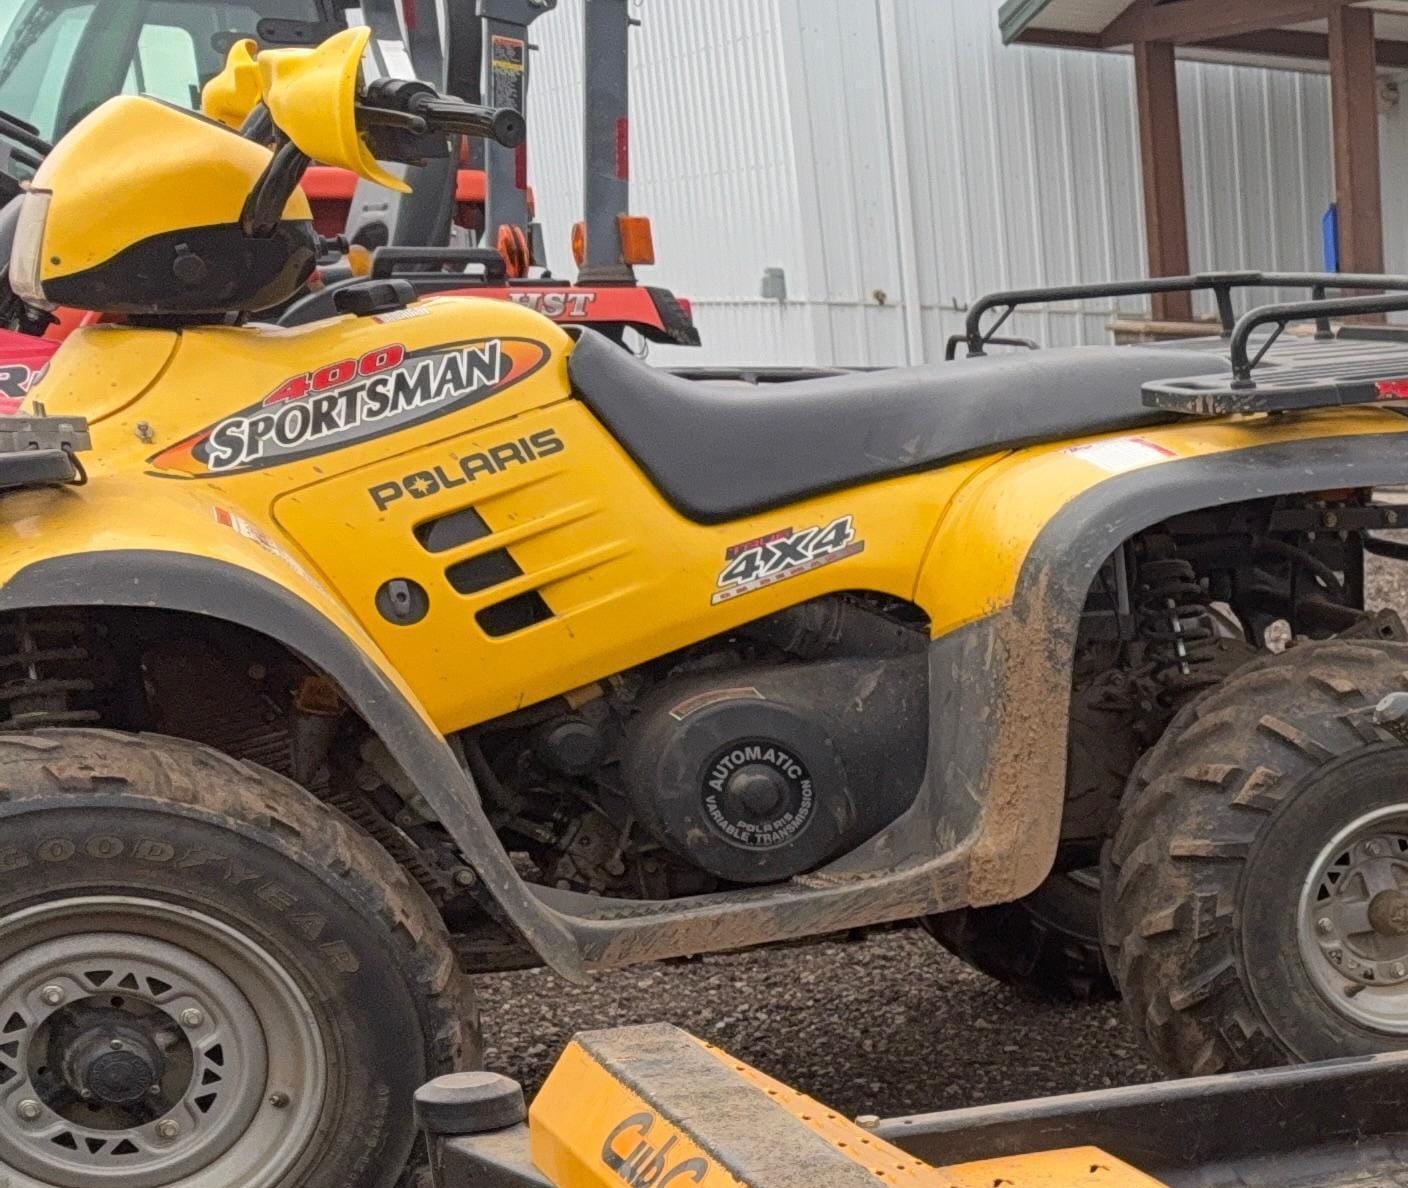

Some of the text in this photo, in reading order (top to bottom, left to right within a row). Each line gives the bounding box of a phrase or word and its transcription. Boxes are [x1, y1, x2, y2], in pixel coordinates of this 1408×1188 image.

[208, 339, 502, 471] SPORTSMAN
[262, 344, 407, 406] 400
[367, 428, 566, 512] POLARIS
[708, 746, 802, 792] AUTOMATIC
[705, 779, 813, 846] VARIABLE TRANSMISSION
[736, 811, 794, 833] POLARIS
